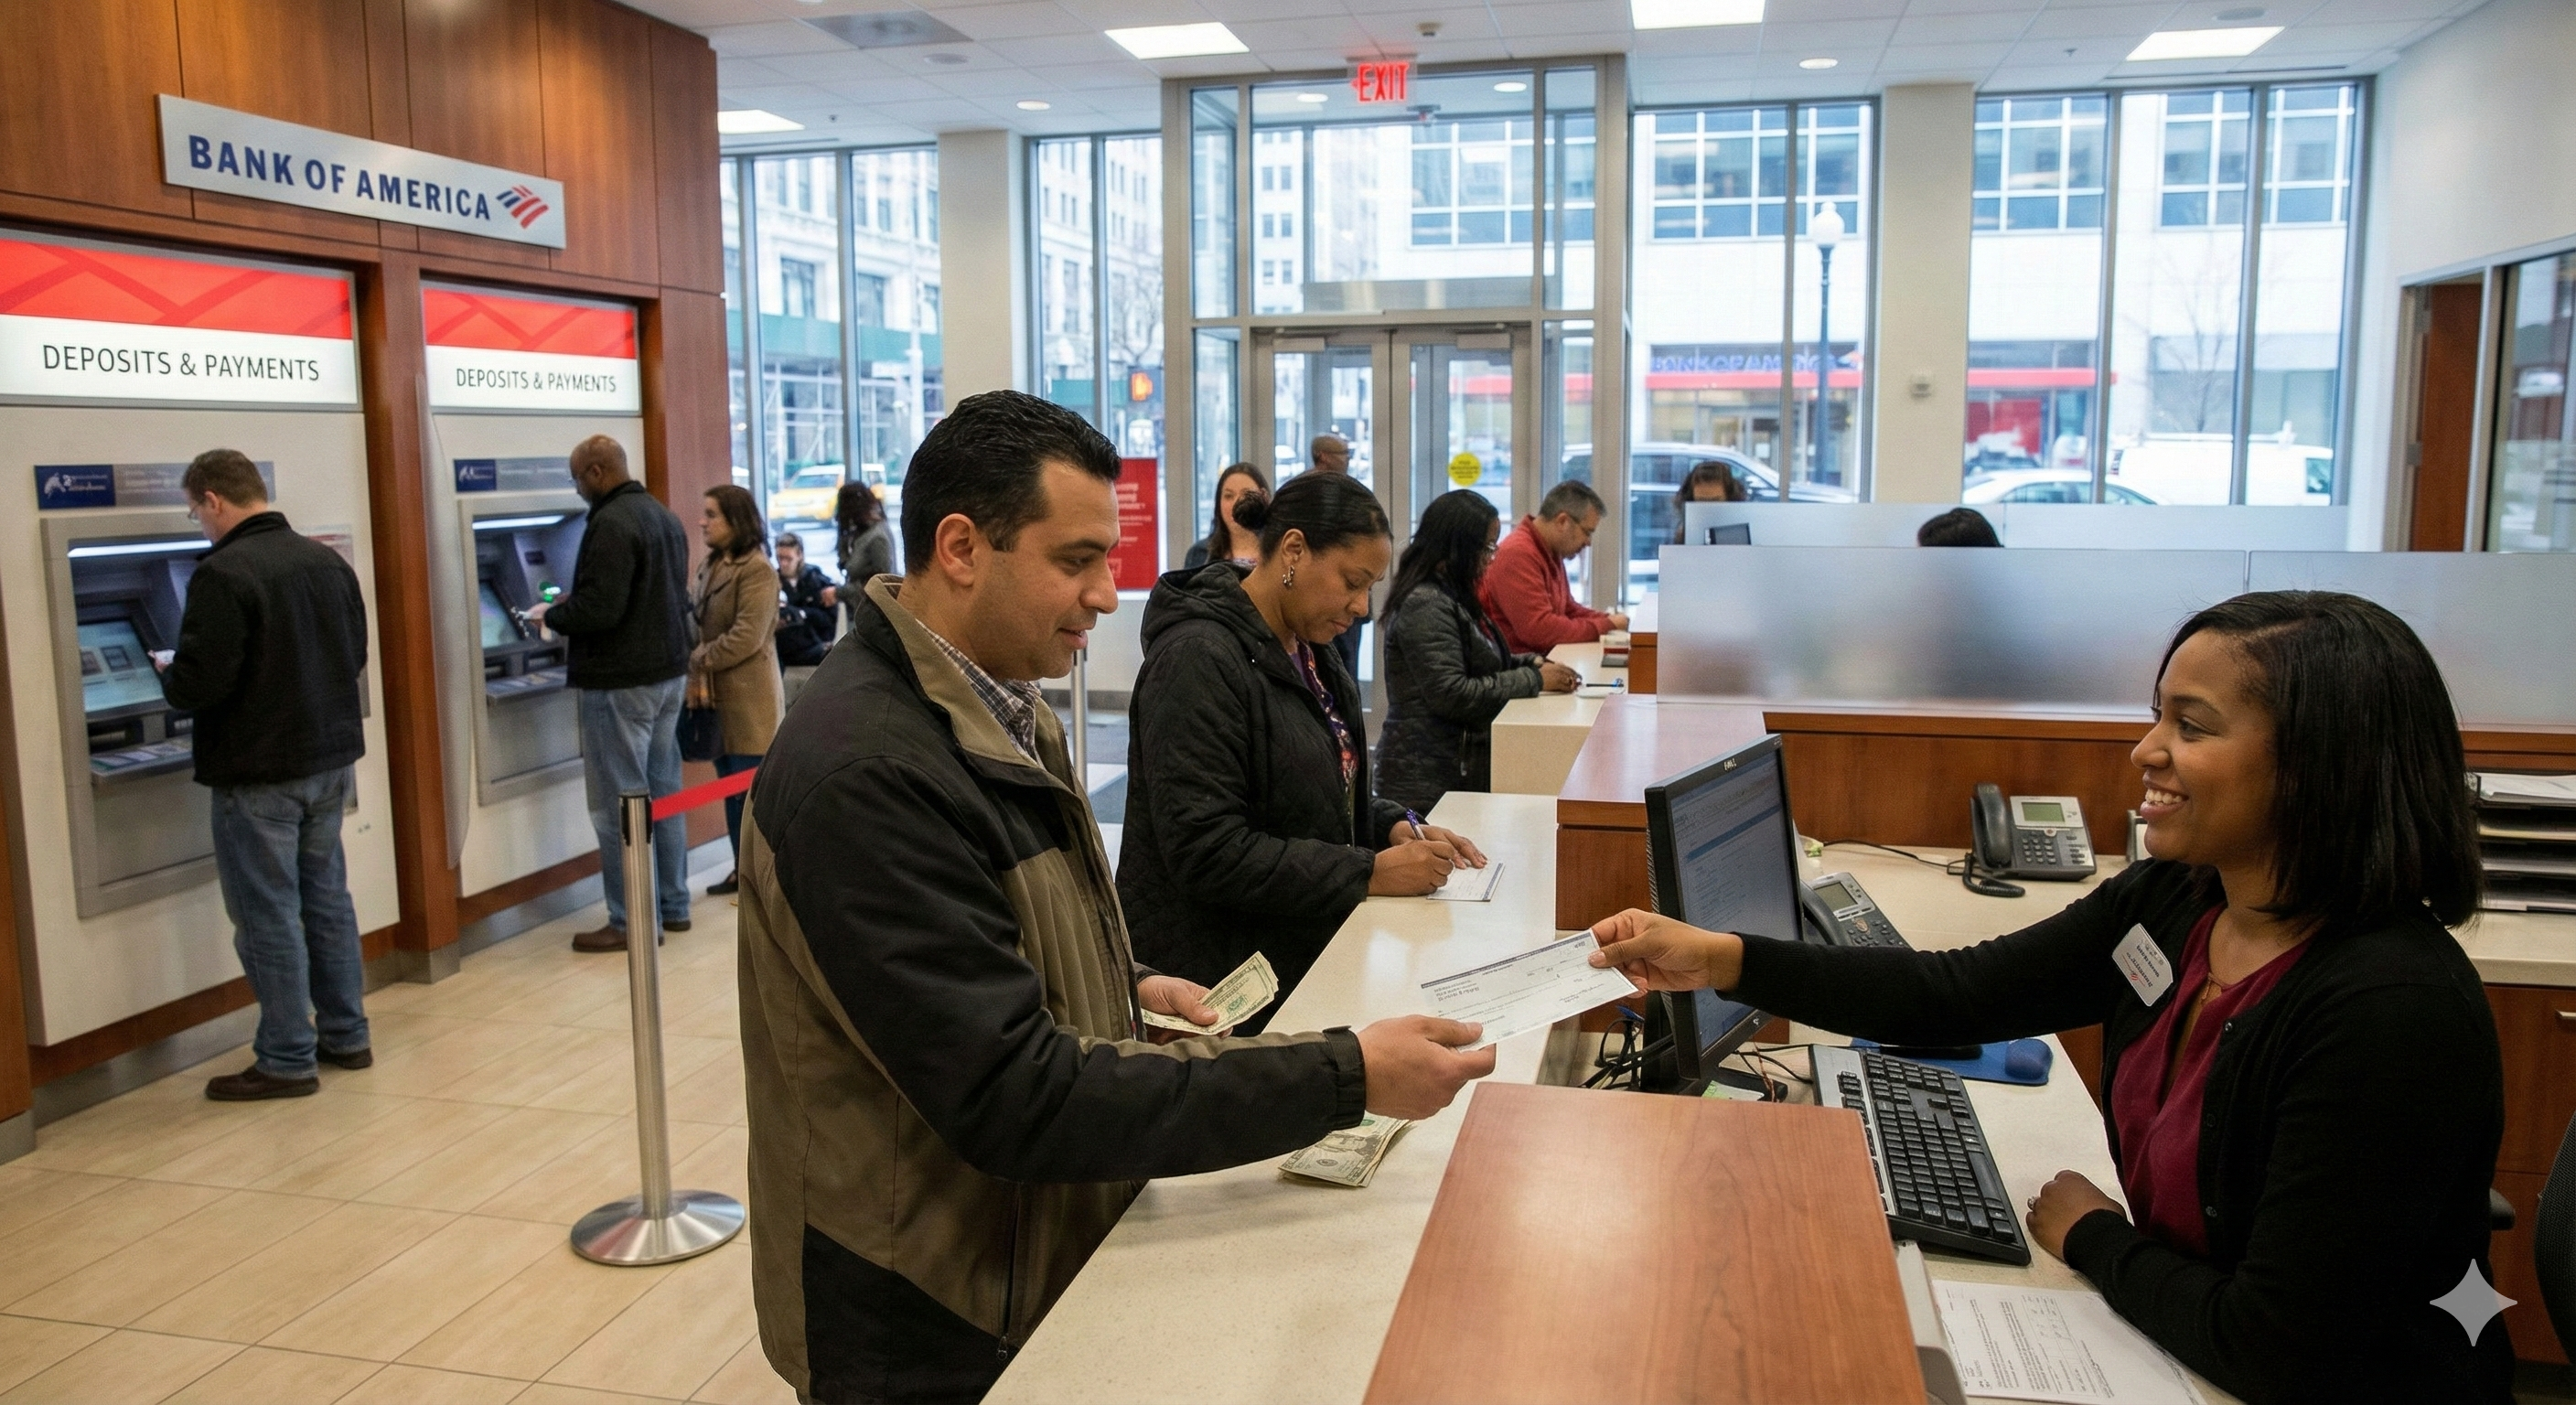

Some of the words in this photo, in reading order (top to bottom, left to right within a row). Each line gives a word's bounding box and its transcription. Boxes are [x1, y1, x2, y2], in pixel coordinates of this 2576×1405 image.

[1358, 63, 1409, 102] EXIT
[188, 134, 295, 186] BANK
[305, 159, 346, 193] OF
[356, 169, 490, 221] AMERICA
[43, 344, 171, 375] DEPOSITS
[180, 353, 197, 376] &
[205, 354, 319, 381] PAYMENTS
[456, 368, 529, 390] DEPOSITS
[533, 372, 543, 390] &
[548, 372, 617, 392] PAYMENTS
